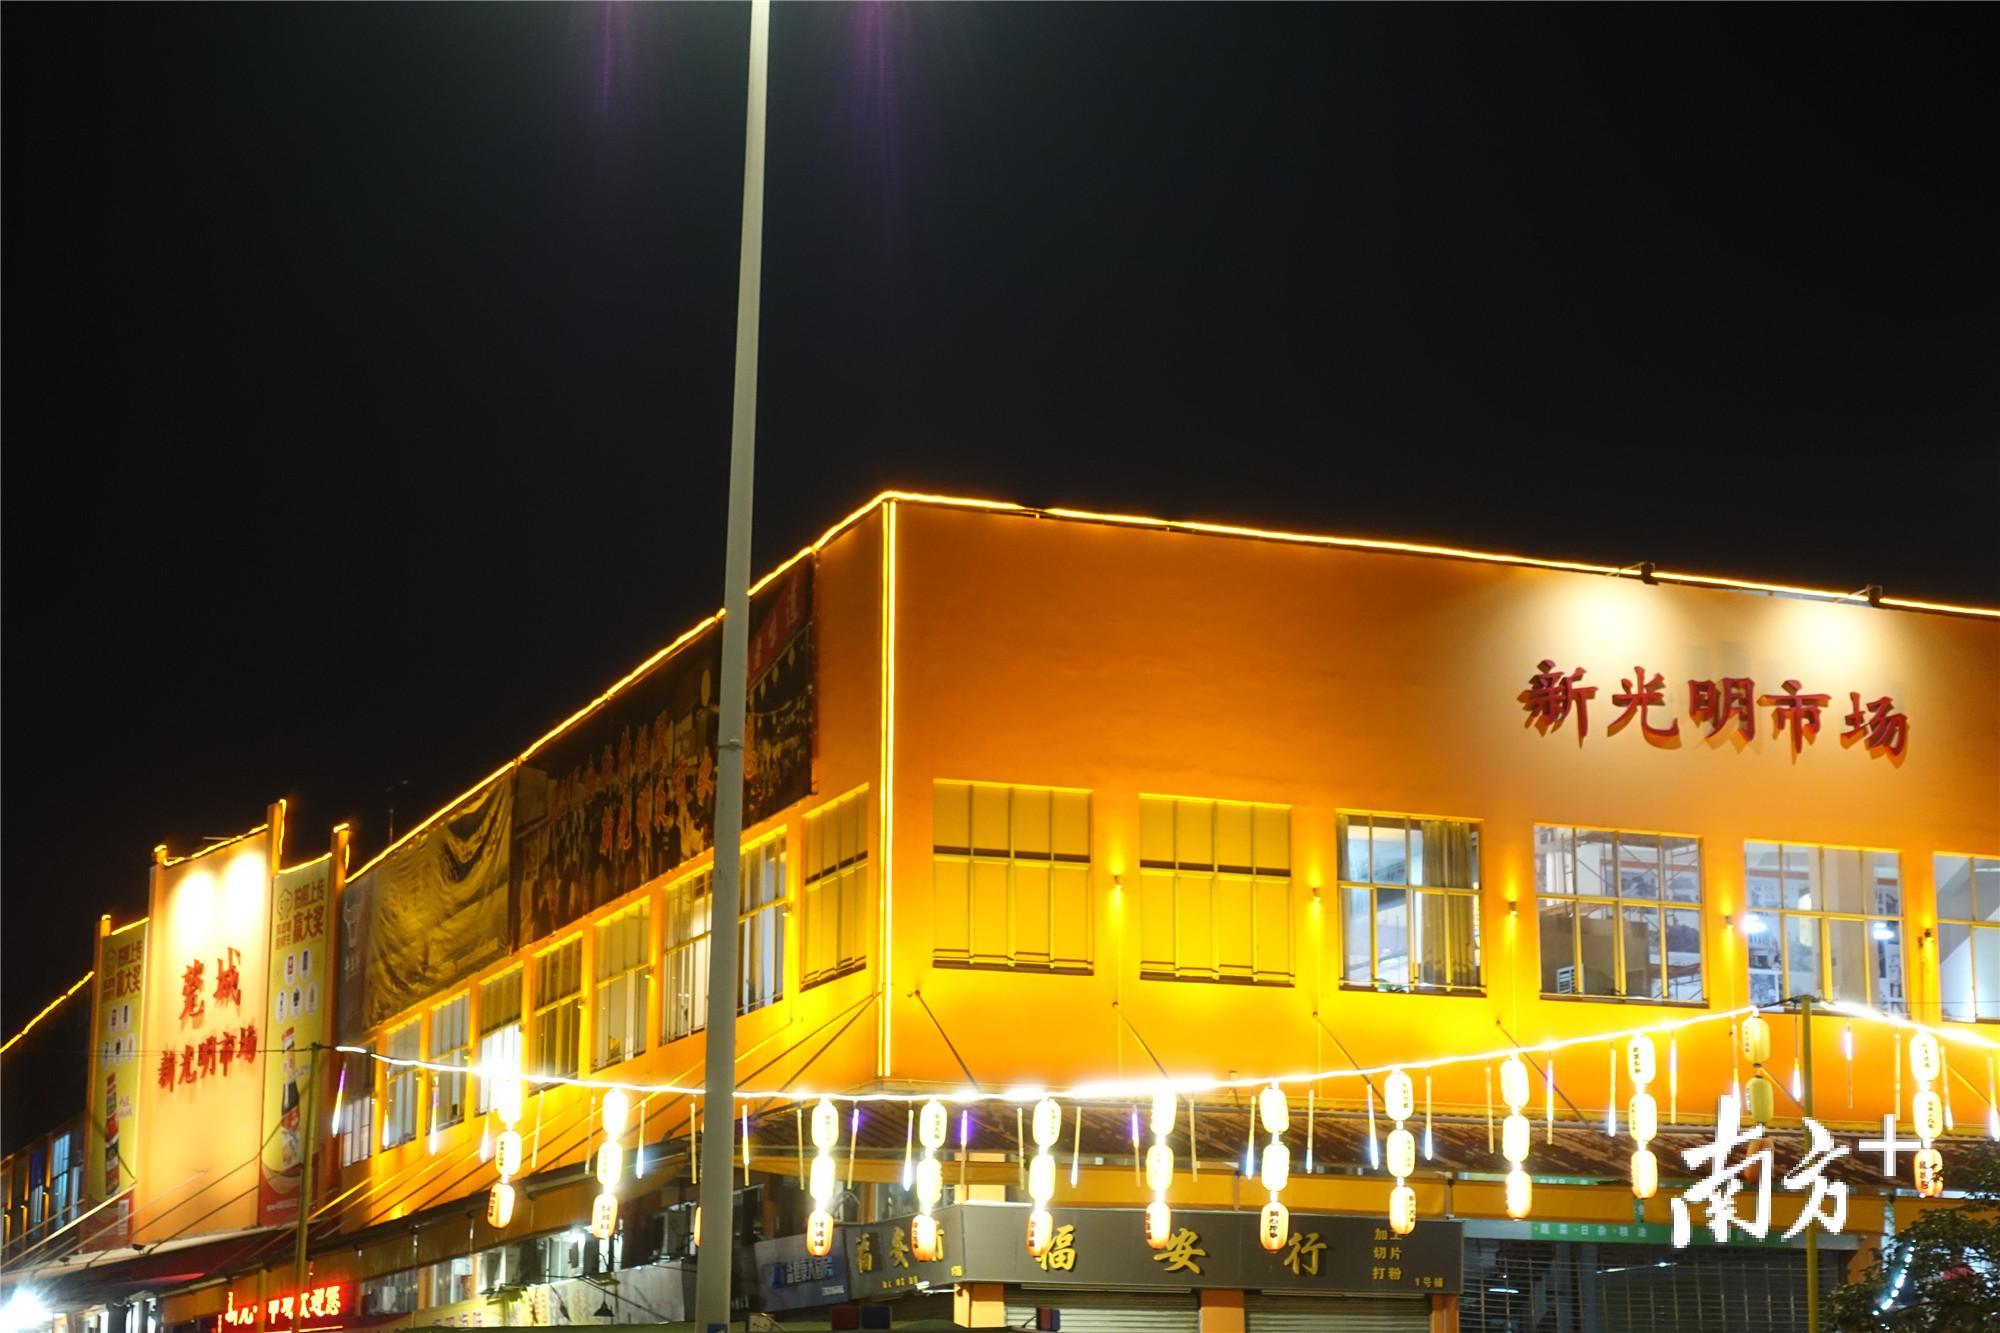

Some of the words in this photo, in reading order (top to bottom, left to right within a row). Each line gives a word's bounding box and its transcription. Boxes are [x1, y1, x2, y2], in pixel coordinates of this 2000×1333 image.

[1520, 659, 1909, 761] 新光明市场
[179, 947, 242, 1020] 莞城
[158, 1025, 258, 1093] 新光明市场
[1373, 1246, 1402, 1260] 切片
